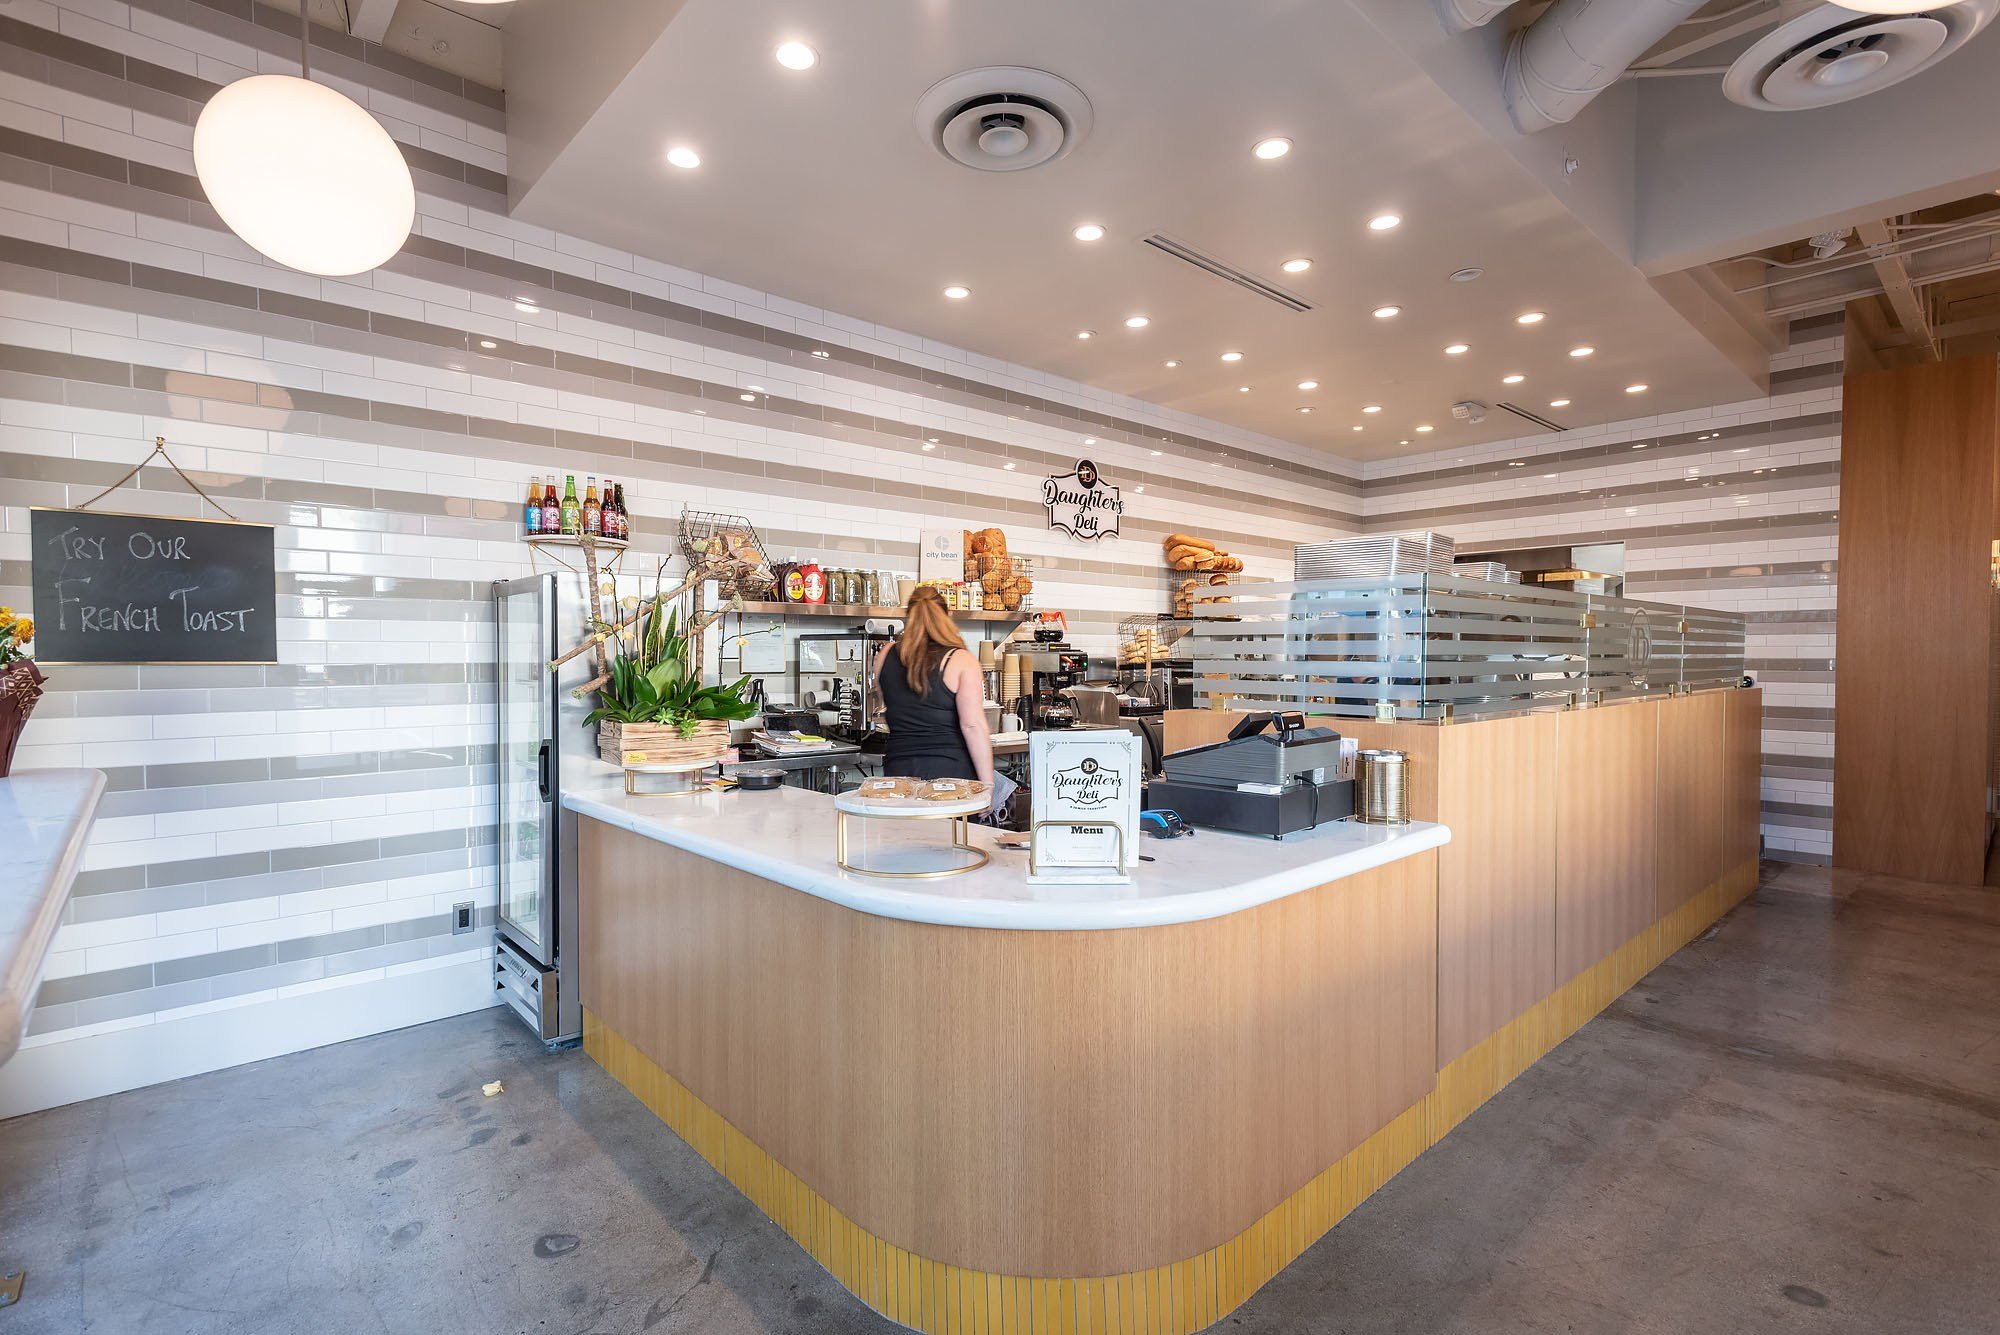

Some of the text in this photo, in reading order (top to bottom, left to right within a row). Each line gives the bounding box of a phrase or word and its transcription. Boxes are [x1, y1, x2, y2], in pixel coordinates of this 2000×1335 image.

[1073, 513, 1099, 531] Deli
[1077, 790, 1099, 799] Deli
[1071, 826, 1104, 834] Menu
